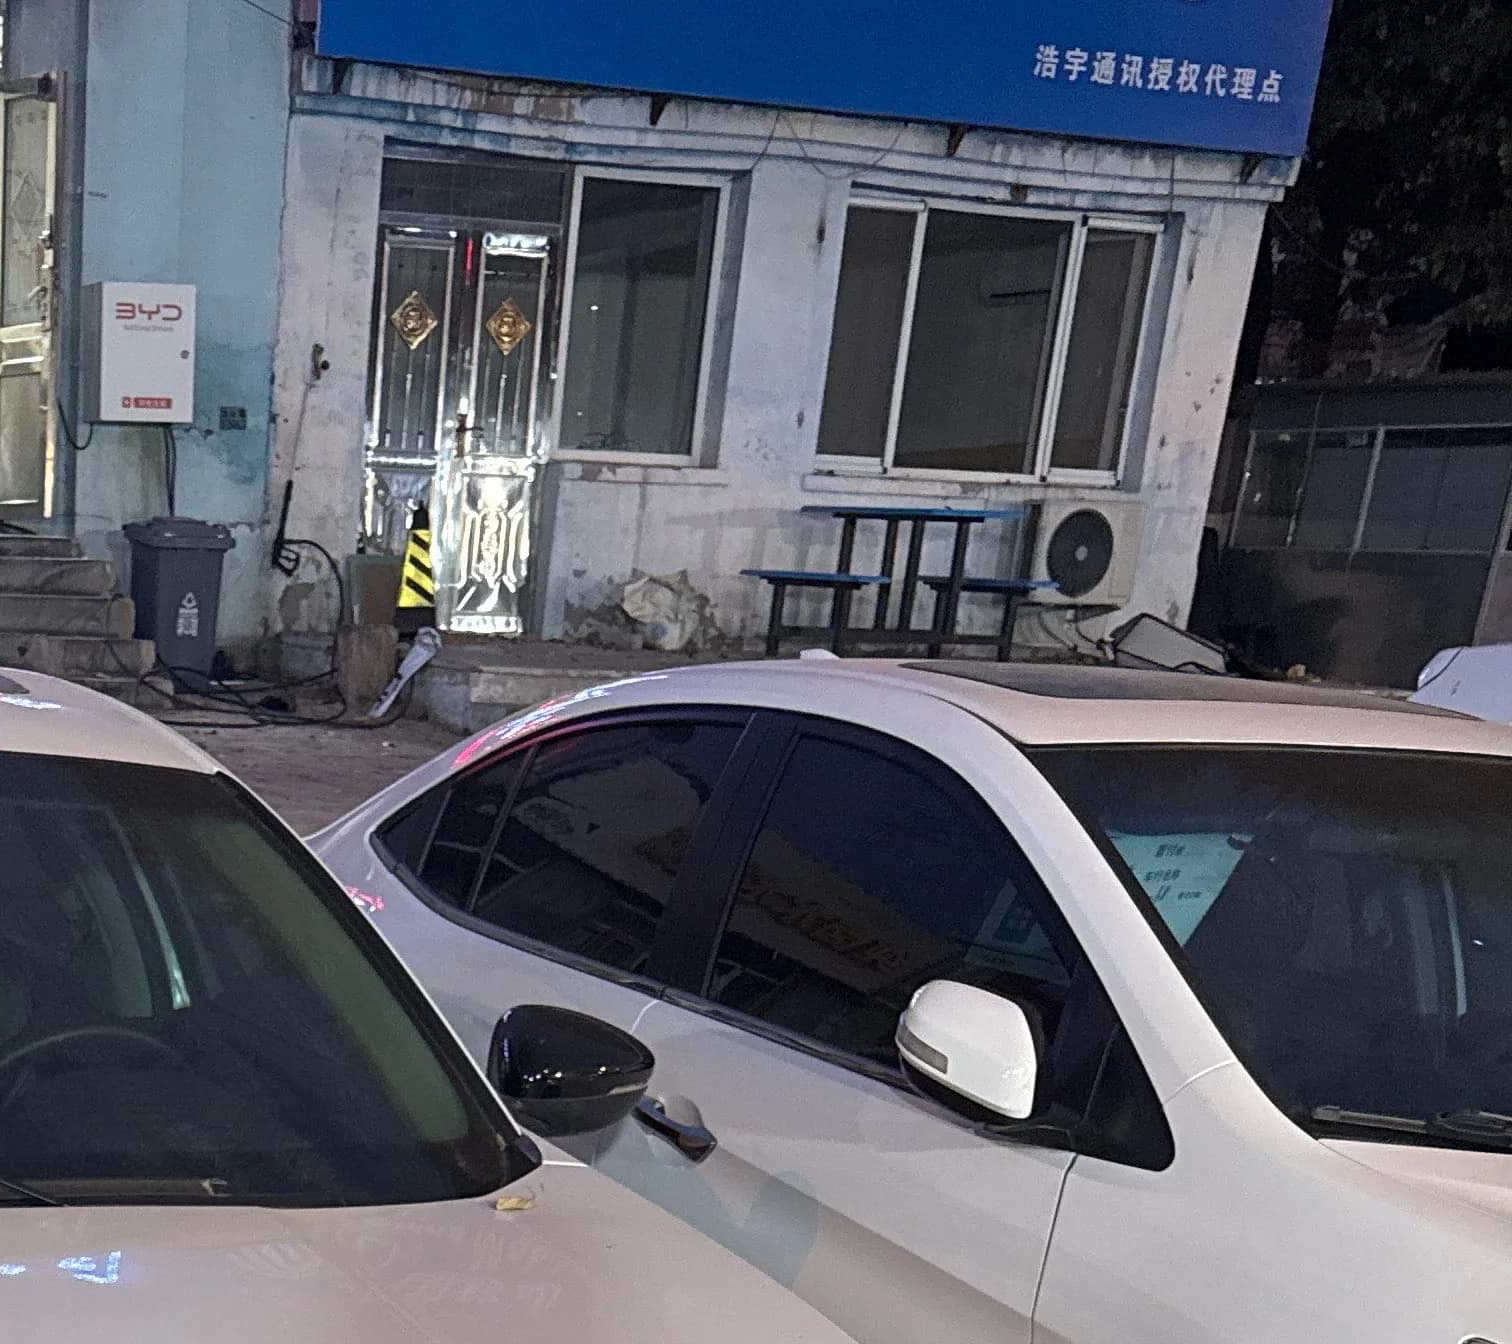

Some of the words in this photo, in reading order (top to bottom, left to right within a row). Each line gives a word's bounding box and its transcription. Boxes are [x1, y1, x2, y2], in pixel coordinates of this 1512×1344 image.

[1033, 45, 1284, 103] 浩宇通讯授权代理点
[115, 302, 183, 321] BYD
